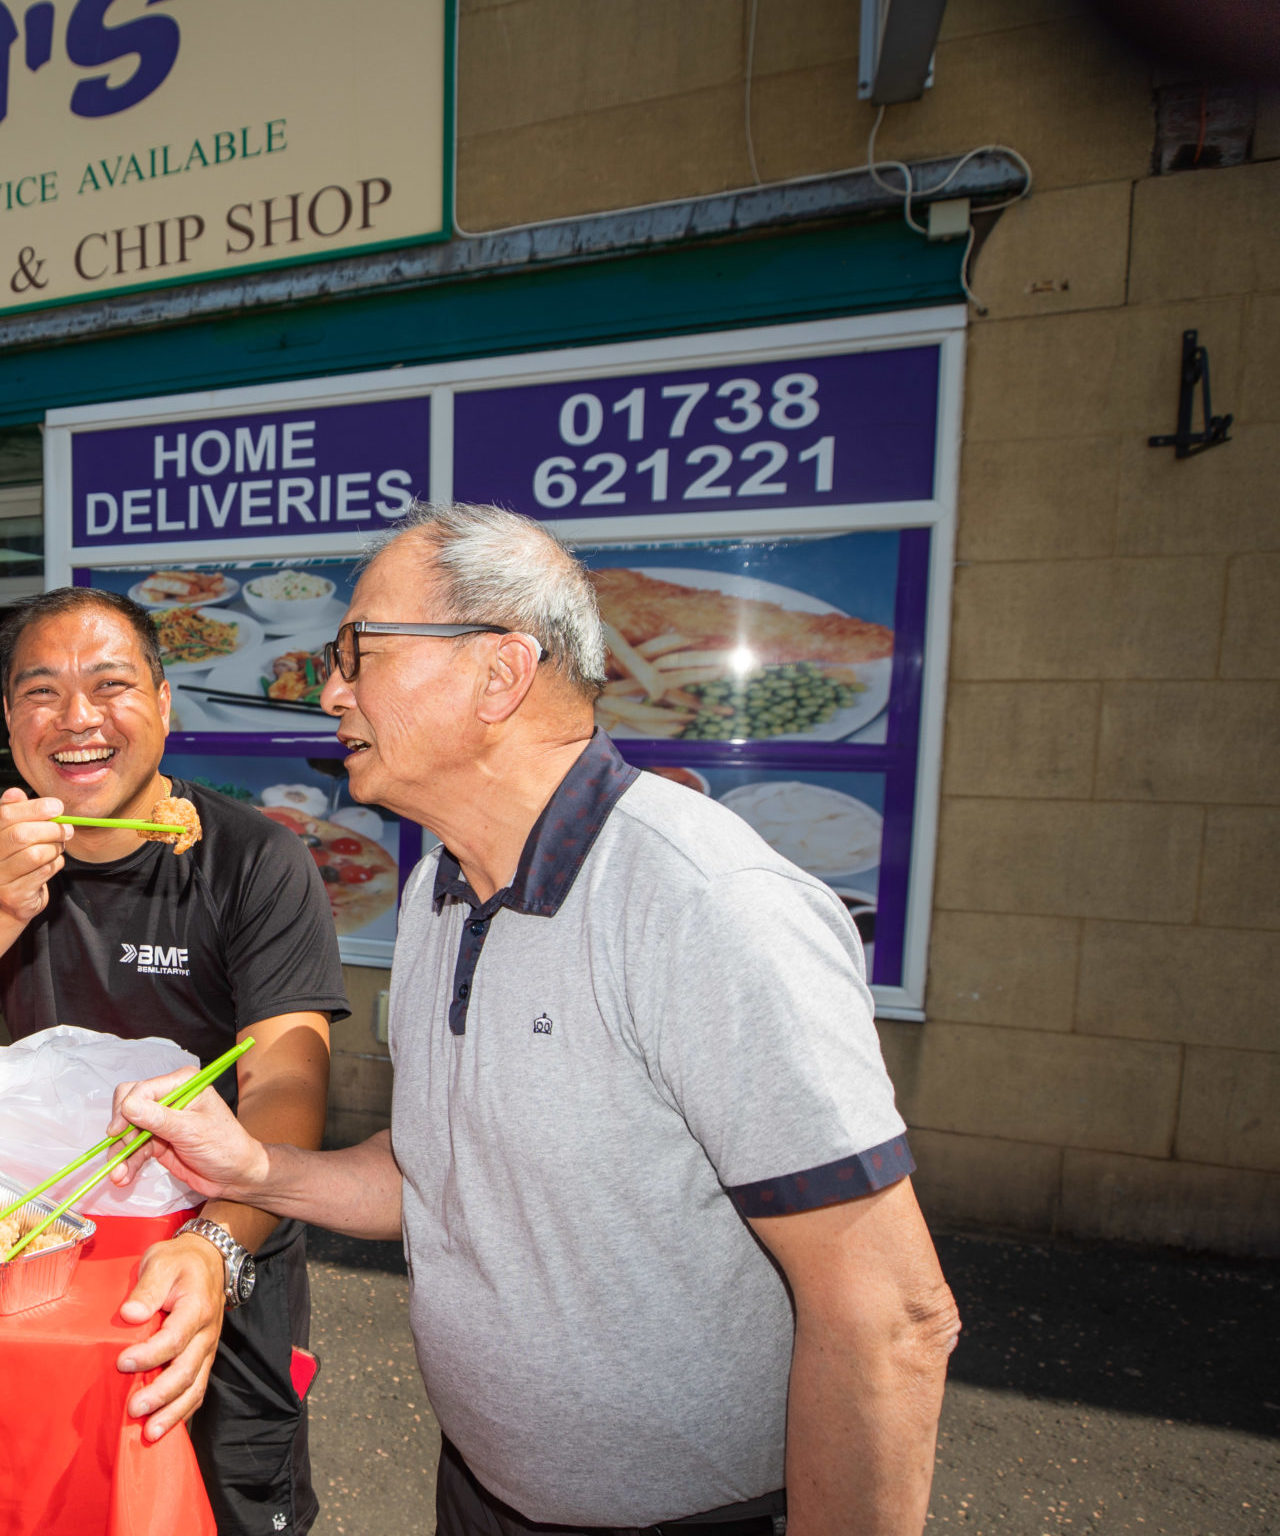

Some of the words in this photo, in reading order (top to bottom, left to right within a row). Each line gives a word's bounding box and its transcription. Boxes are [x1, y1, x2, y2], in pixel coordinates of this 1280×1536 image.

[77, 118, 288, 195] AVAILABLE
[10, 246, 50, 294] &
[74, 214, 206, 282] CHIP
[226, 177, 393, 255] SHOP
[559, 371, 820, 447] 01738
[153, 420, 317, 481] HOME
[533, 435, 836, 509] 621221
[86, 469, 414, 538] DELIVERIES
[137, 944, 189, 968] BMF
